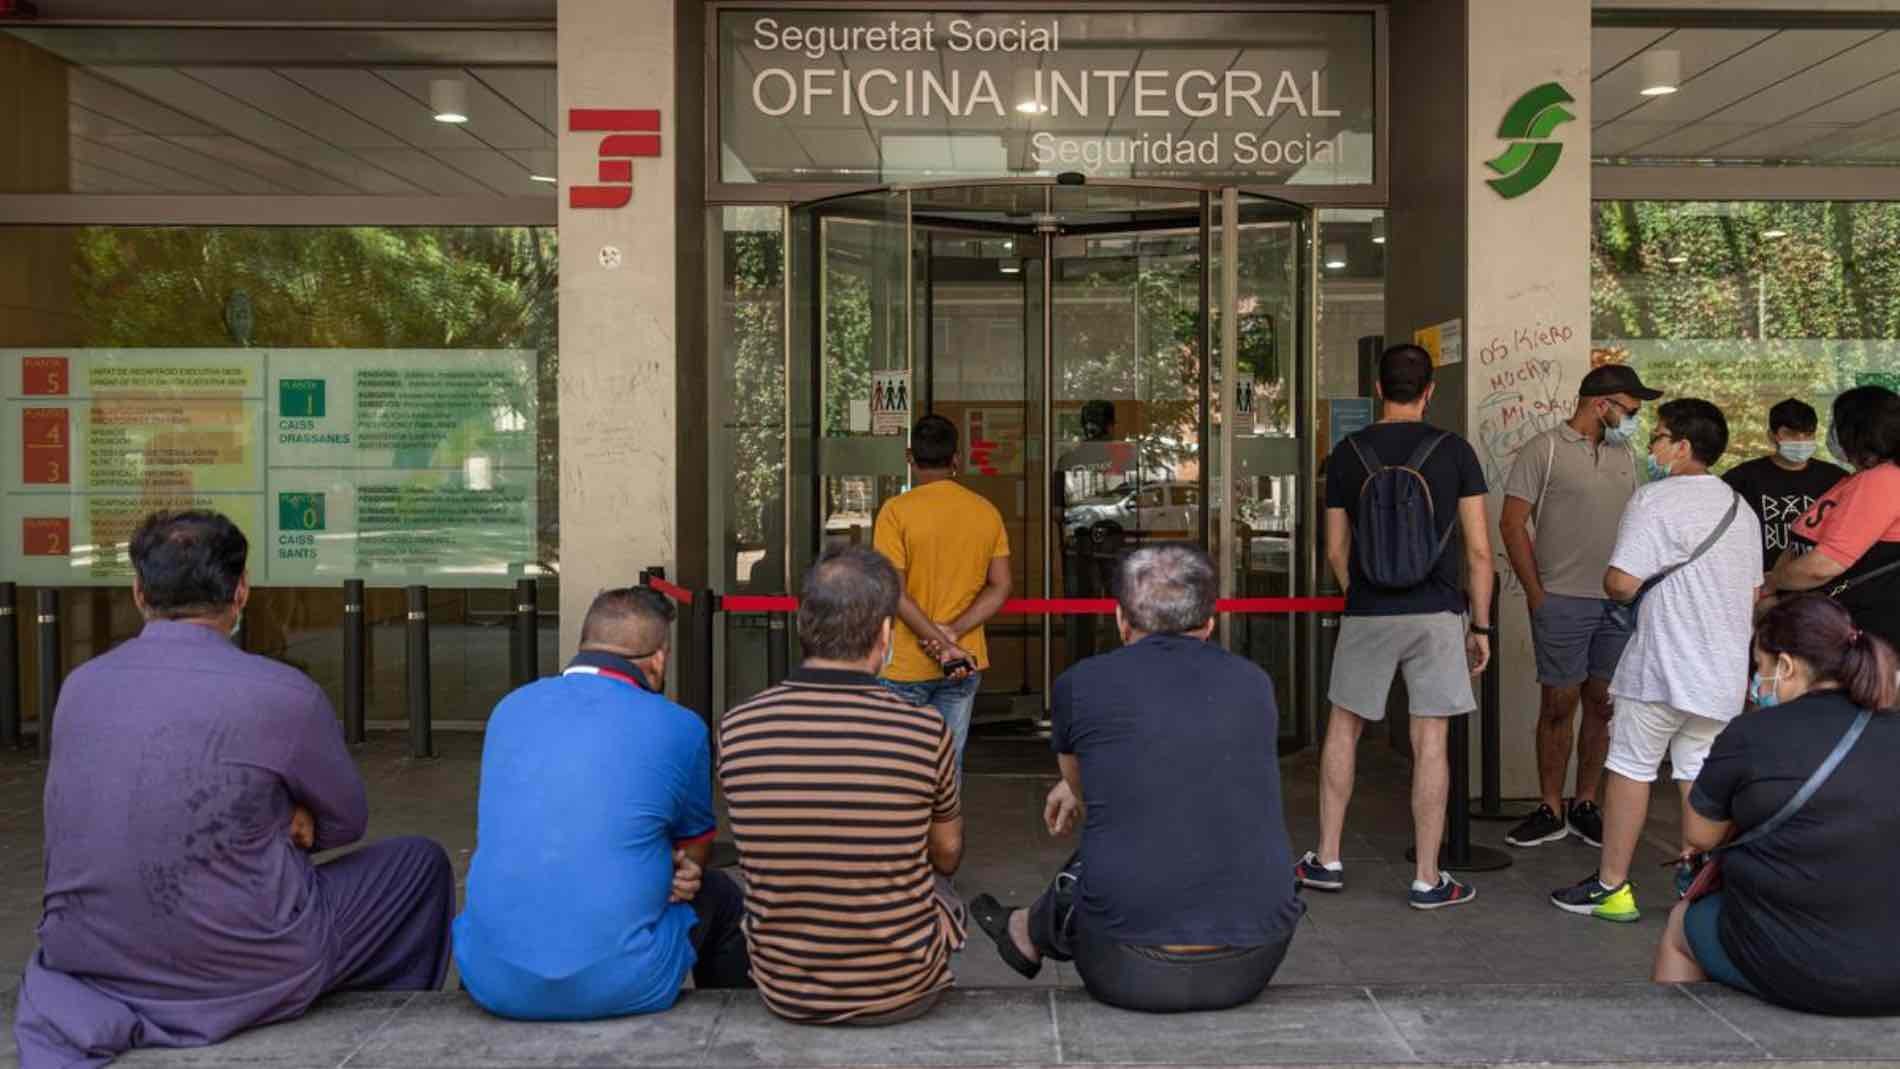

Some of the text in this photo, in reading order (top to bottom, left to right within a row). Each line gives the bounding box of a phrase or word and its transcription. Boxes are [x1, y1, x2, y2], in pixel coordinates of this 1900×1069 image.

[753, 18, 1059, 59] Seguretat Social
[752, 68, 1342, 118] OFICINA INTEGRAL
[1031, 131, 1344, 169] Seguridad Social
[48, 372, 59, 393] 5
[46, 426, 60, 443] 4
[48, 463, 60, 482] 3
